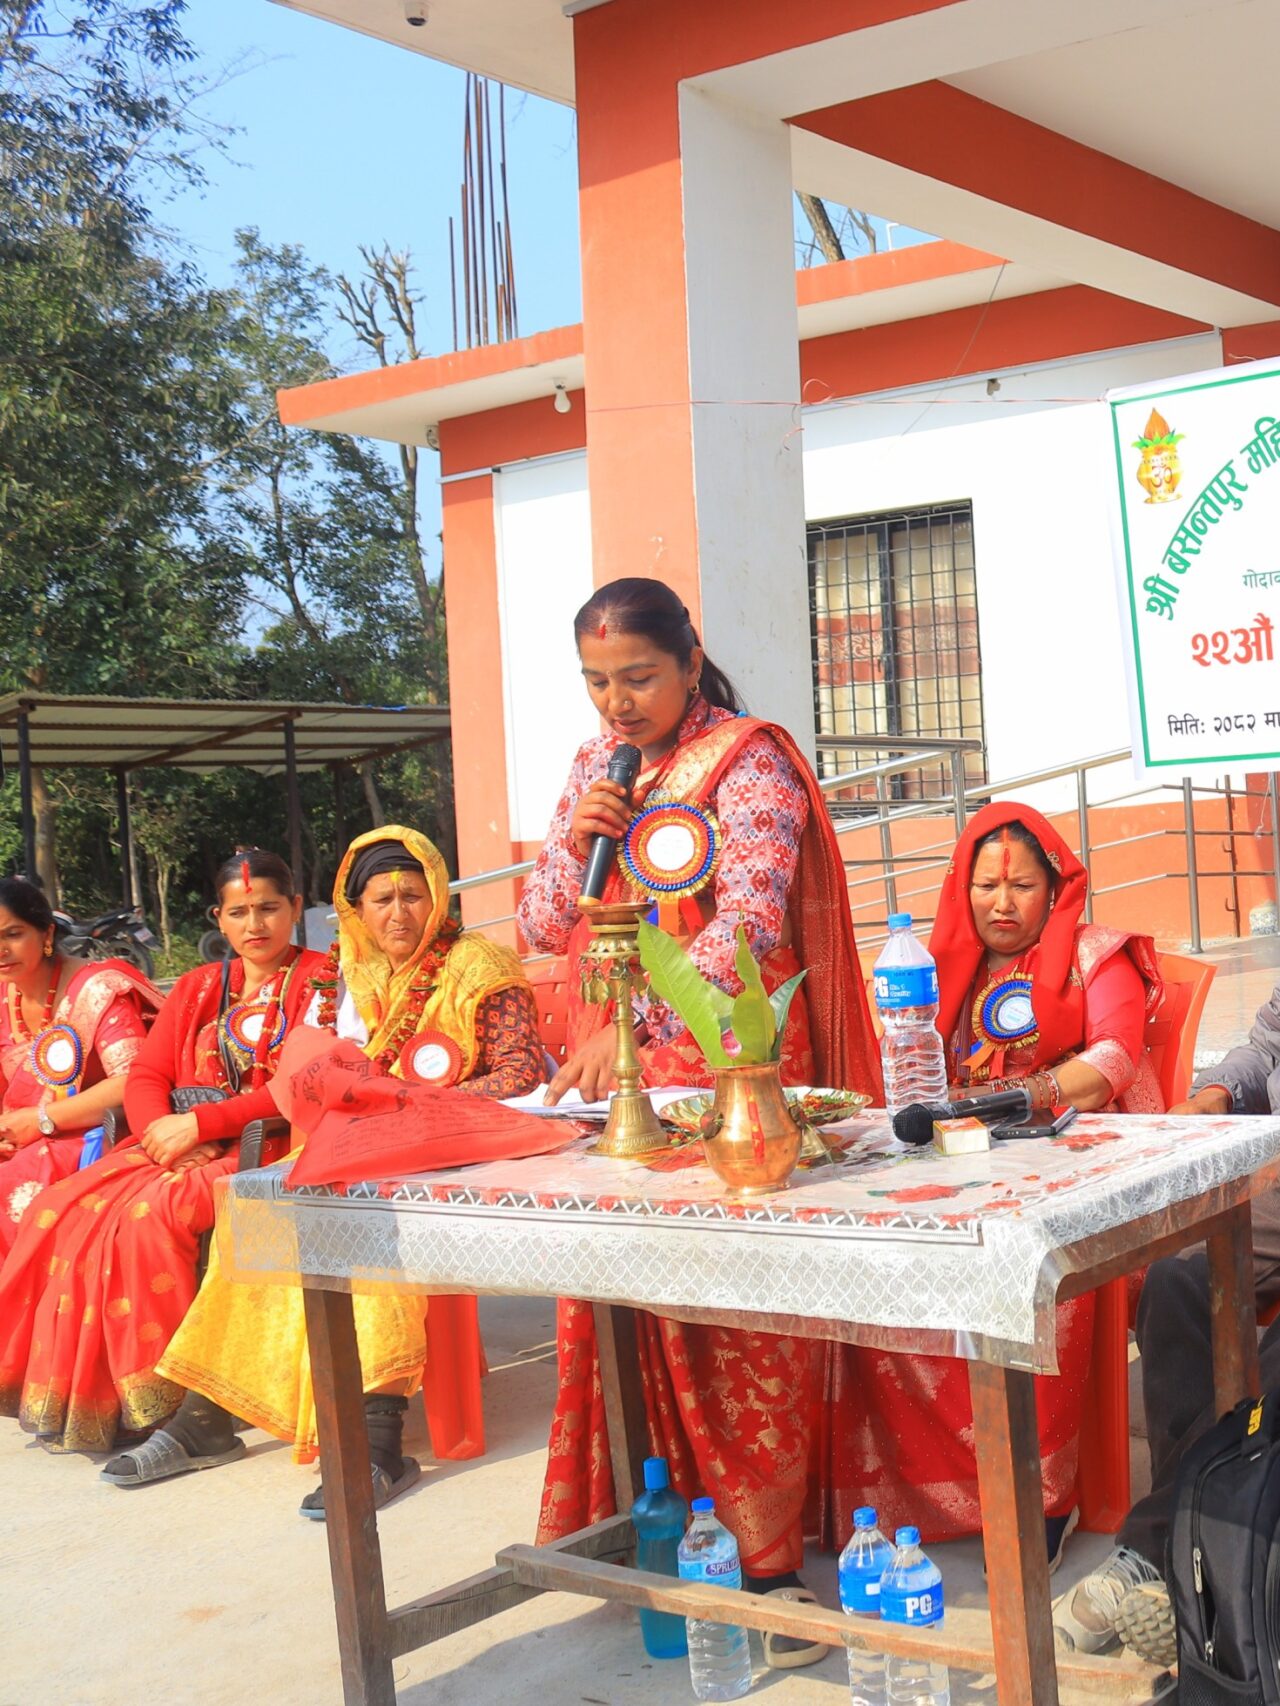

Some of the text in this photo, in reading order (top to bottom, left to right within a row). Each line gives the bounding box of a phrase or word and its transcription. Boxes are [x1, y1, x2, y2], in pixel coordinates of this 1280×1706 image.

[1142, 572, 1180, 621] श्री
[1161, 459, 1249, 575] बसन्तपुर
[1214, 714, 1256, 737] २०८२
[905, 1594, 932, 1619] PG
